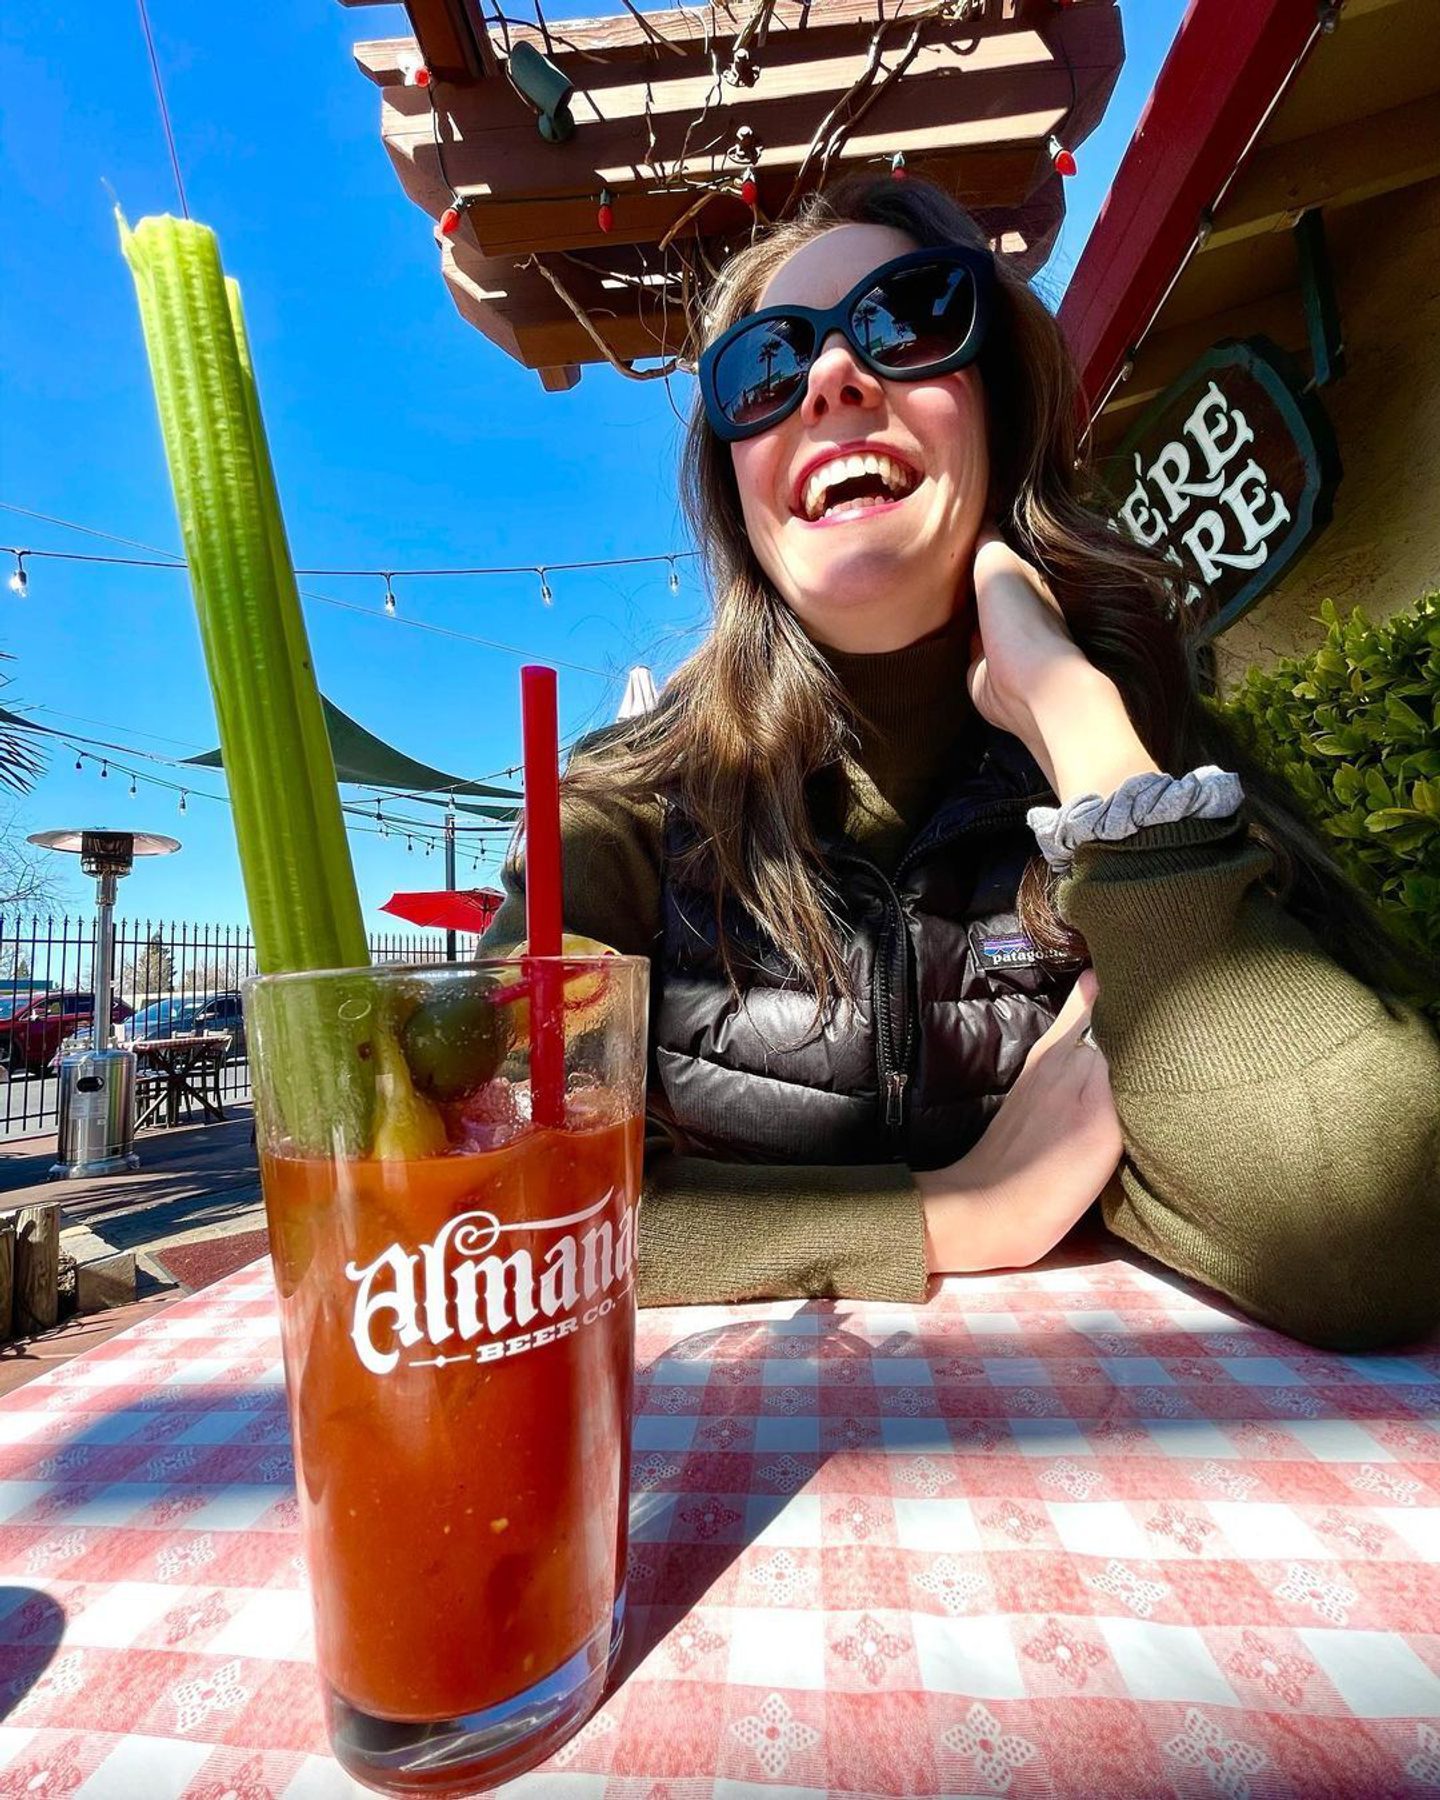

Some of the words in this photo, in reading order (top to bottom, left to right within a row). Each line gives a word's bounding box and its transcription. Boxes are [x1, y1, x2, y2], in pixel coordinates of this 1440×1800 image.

[1106, 381, 1254, 548] E'RE
[345, 1186, 641, 1375] Almana
[476, 1317, 579, 1363] BEER
[582, 1298, 616, 1326] CO.
